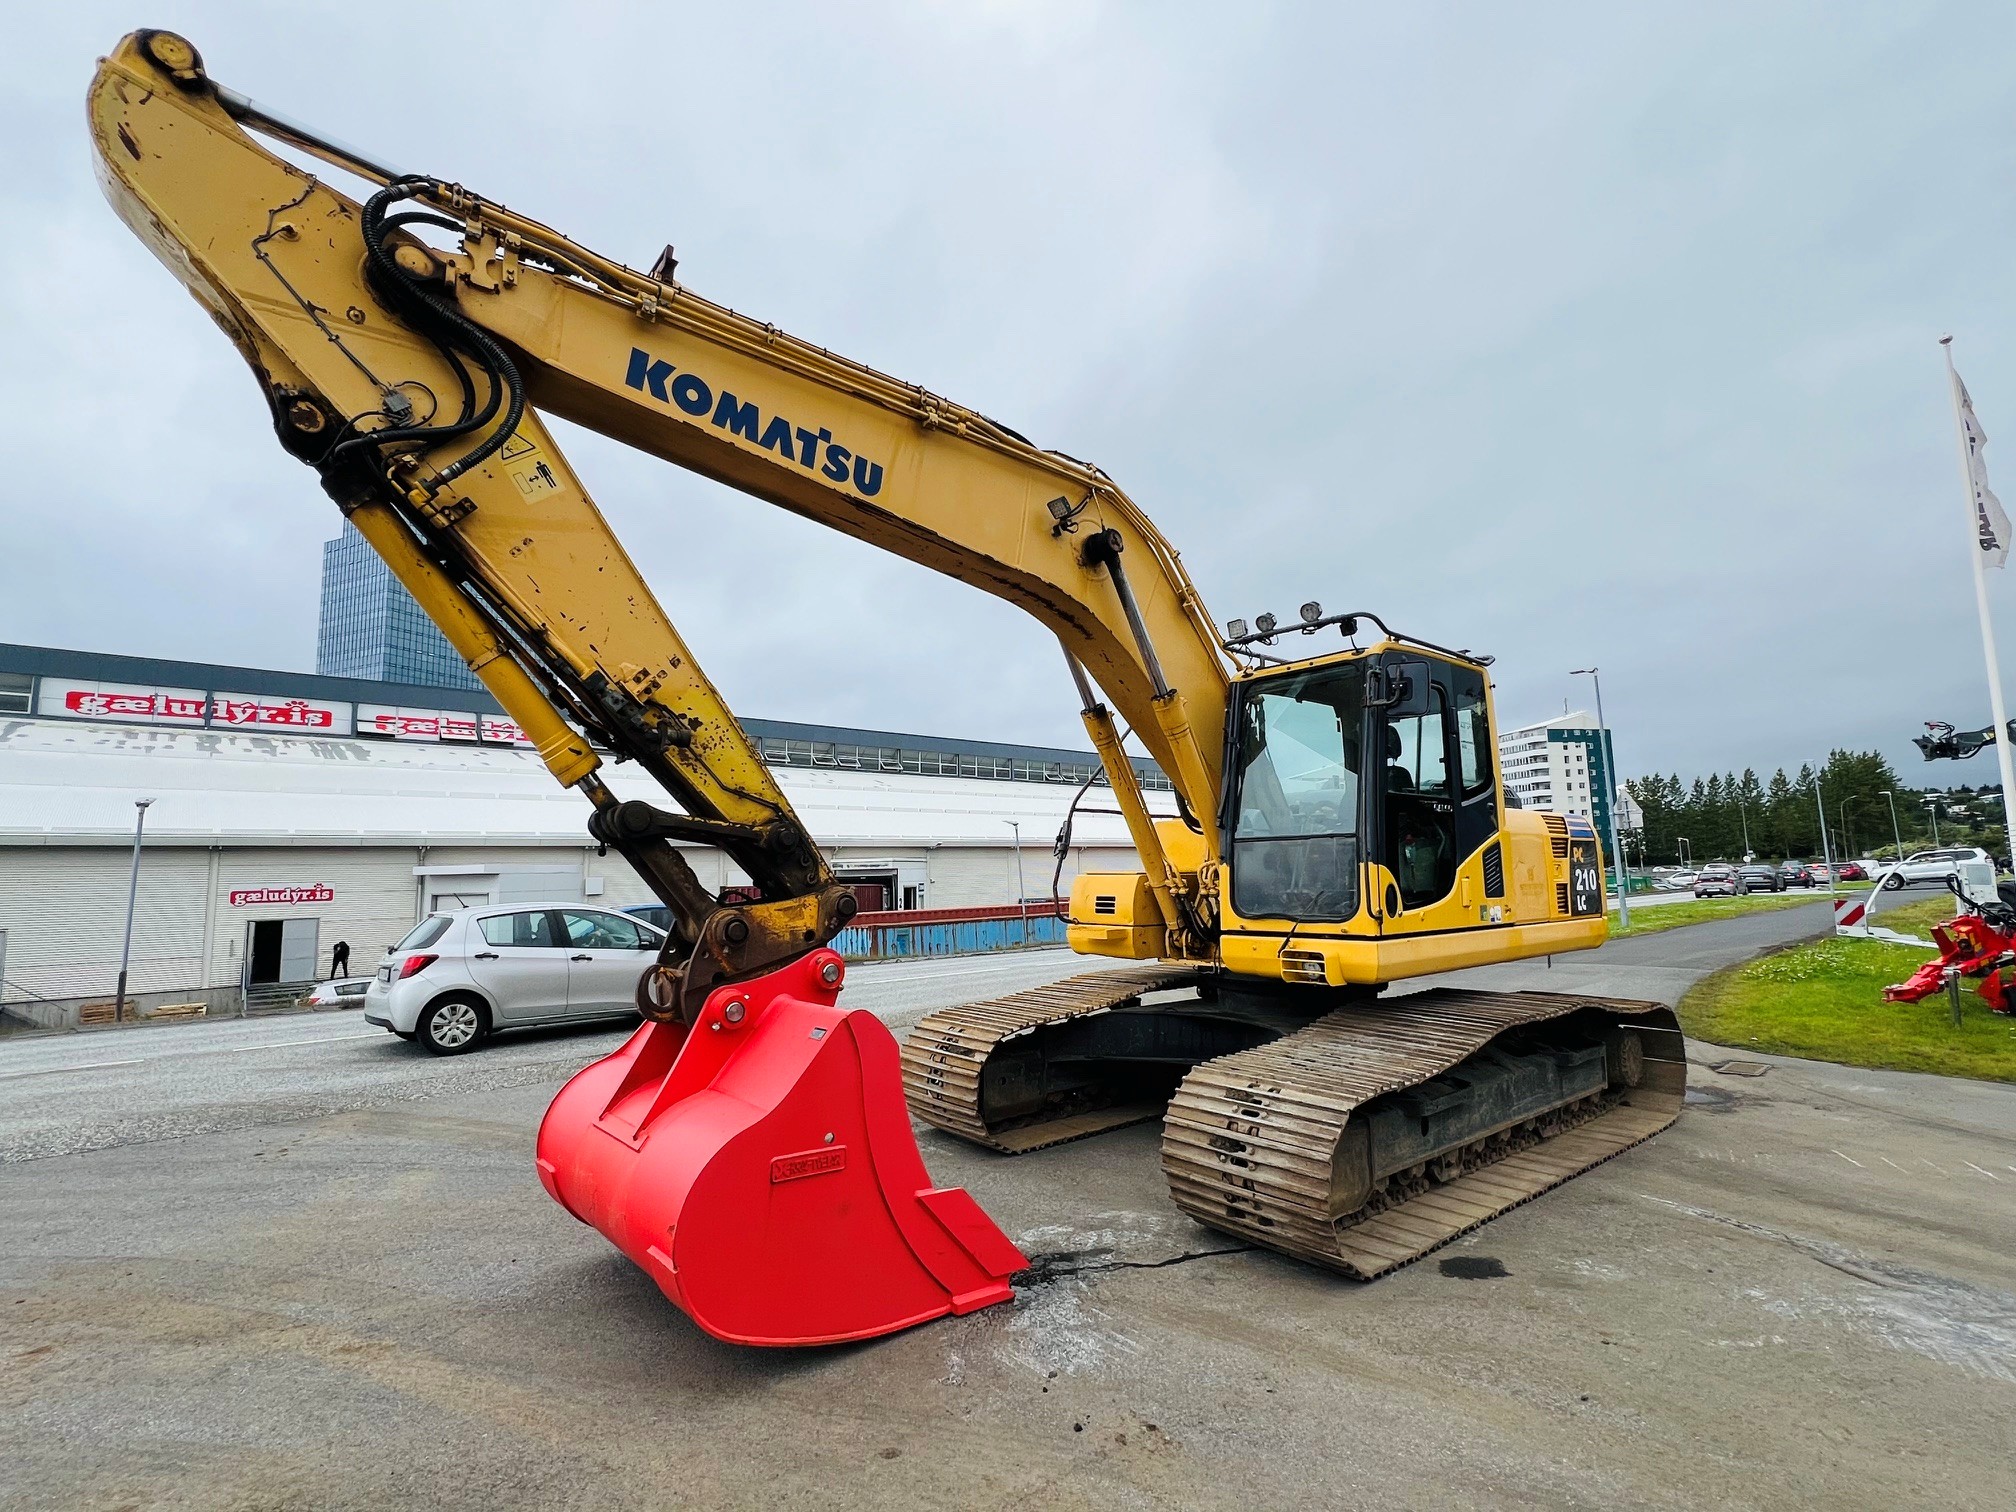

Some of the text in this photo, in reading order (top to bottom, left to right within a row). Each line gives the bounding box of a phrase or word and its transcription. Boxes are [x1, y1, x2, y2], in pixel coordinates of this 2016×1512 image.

[625, 347, 883, 496] KOMATSU
[1573, 847, 1584, 863] PC
[1575, 868, 1597, 891] 210
[234, 886, 330, 907] gæludýr.is
[1577, 895, 1587, 911] LC
